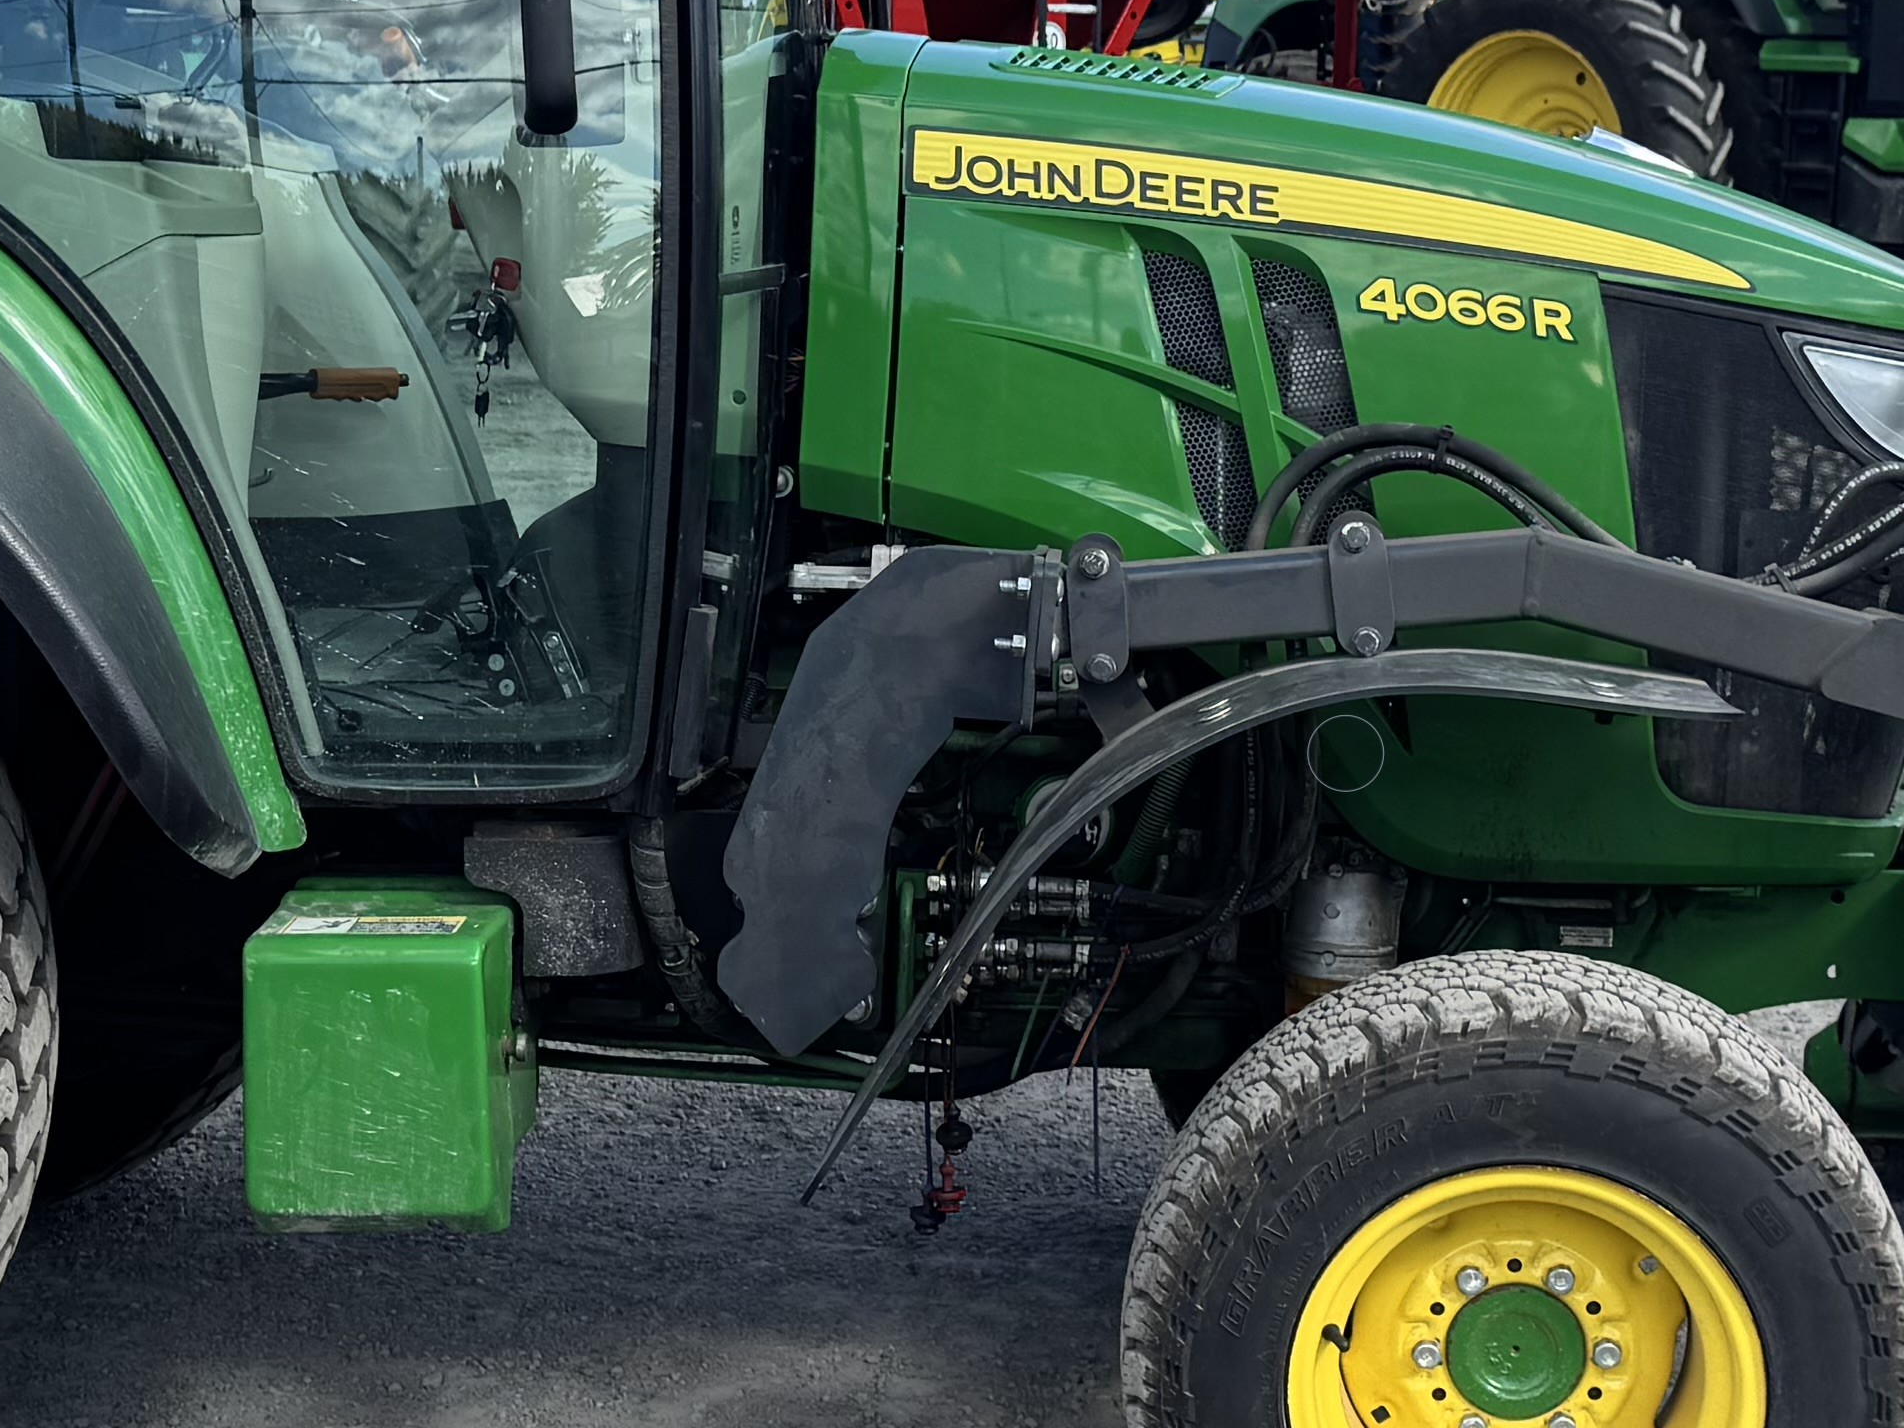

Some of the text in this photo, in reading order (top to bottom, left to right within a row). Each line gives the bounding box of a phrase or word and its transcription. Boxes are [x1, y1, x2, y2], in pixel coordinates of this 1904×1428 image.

[934, 145, 1280, 219] JOHN DEERE
[1358, 277, 1575, 341] 4066 R
[1214, 1114, 1411, 1339] GRABBER
